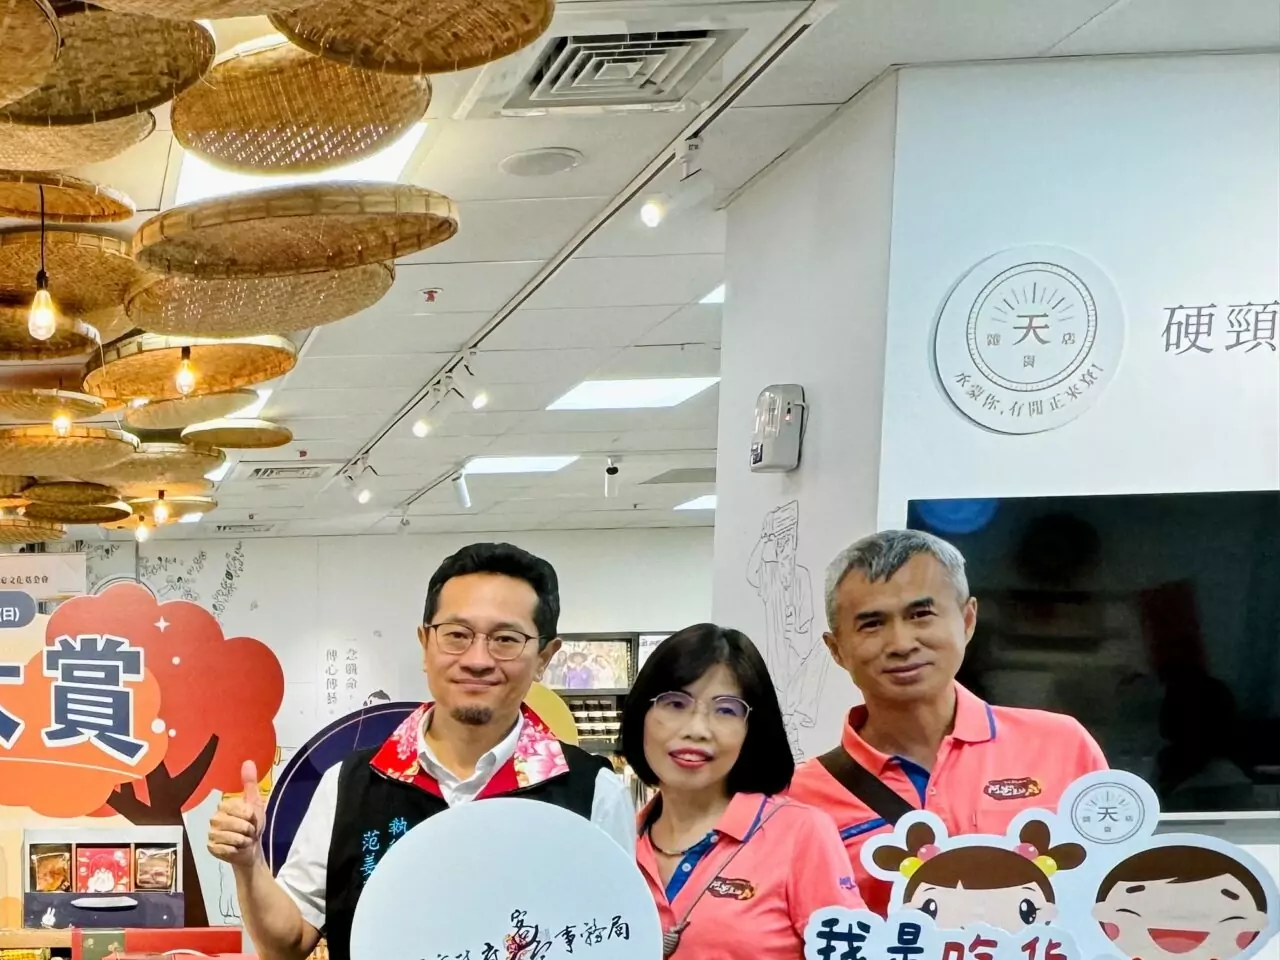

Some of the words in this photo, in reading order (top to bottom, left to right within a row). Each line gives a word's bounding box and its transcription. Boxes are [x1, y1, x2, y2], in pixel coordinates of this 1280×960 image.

[1012, 313, 1051, 345] 天
[1161, 300, 1280, 355] 硬頸
[1097, 806, 1119, 823] 天
